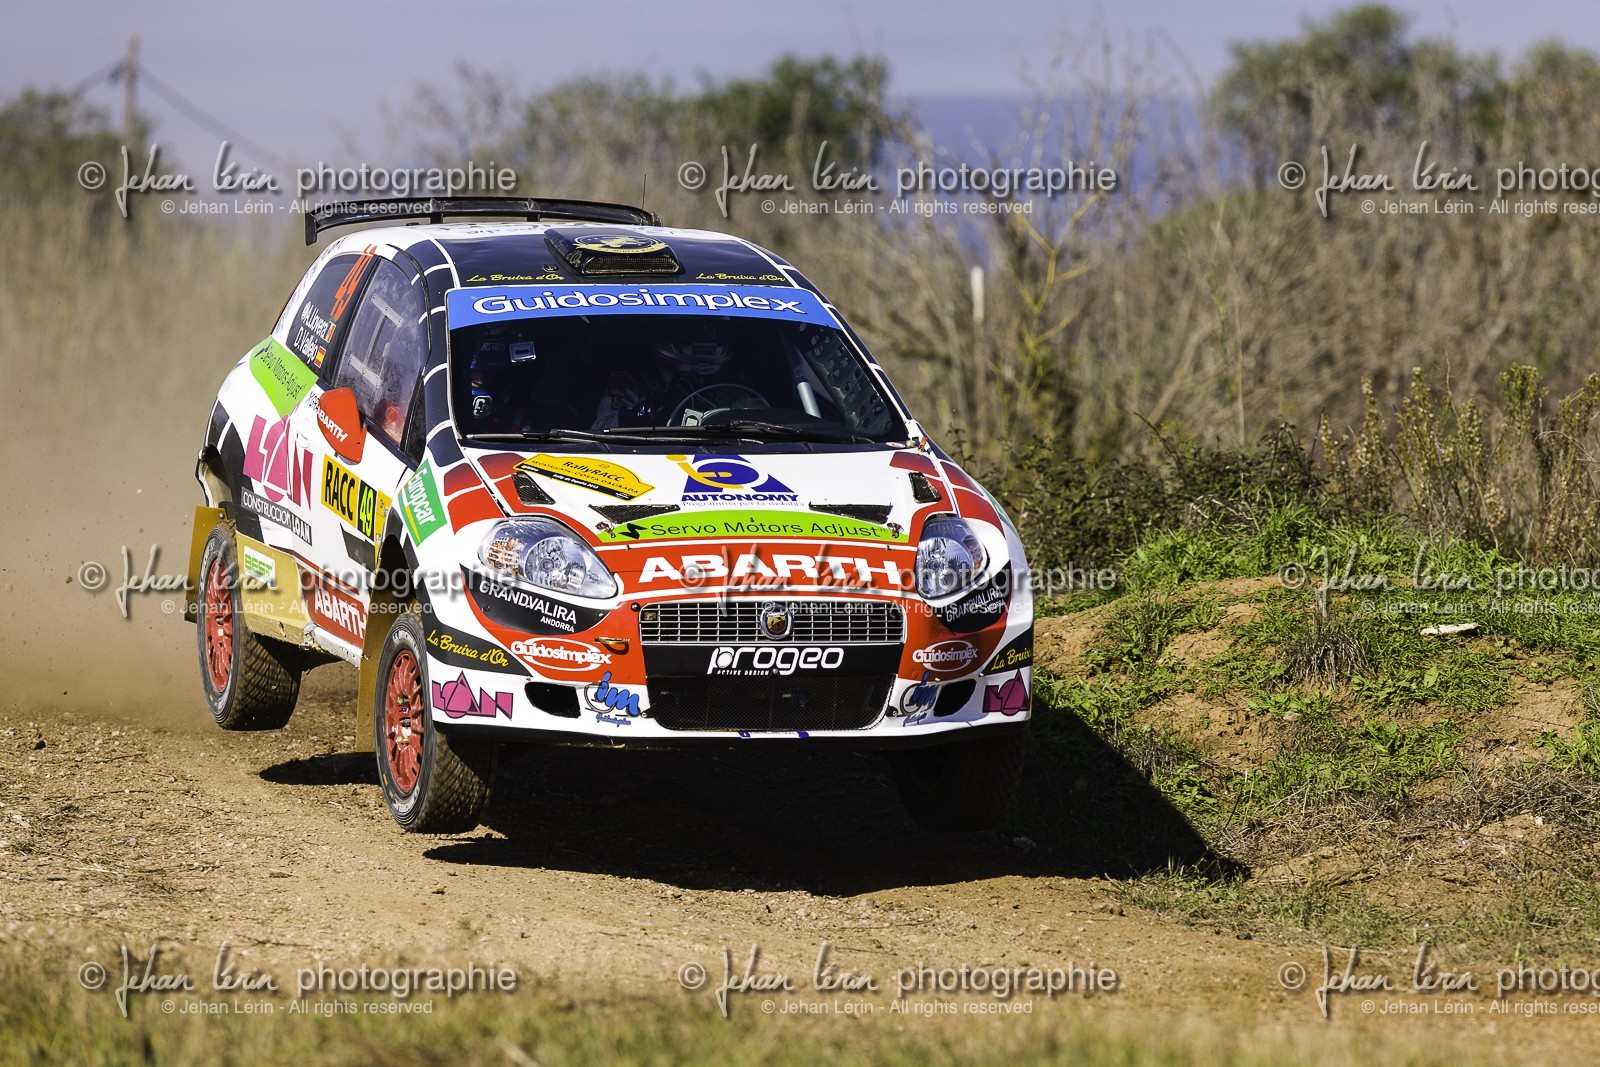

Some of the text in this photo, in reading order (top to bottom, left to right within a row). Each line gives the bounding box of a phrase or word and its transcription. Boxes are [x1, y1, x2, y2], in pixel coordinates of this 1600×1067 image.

[466, 274, 488, 282] La
[715, 272, 757, 280] Bruixa
[472, 288, 807, 314] Guidosimplex
[562, 461, 625, 483] RallyRACC
[325, 461, 374, 537] RACC 49
[407, 467, 437, 526] Europcar
[681, 494, 799, 502] AUTONOMY
[292, 513, 311, 544] LOAN
[651, 522, 716, 536] Servo
[724, 520, 804, 534] Motors
[638, 553, 902, 585] ABARTH
[315, 585, 367, 639] ABARTH
[480, 580, 577, 624] GRANDVALIRA
[540, 616, 575, 633] ANDORRA
[426, 629, 439, 646] La
[440, 634, 479, 659] Bruixa
[480, 648, 509, 667] d'Or
[510, 640, 612, 664] Guidosimplex
[912, 648, 978, 663] Guidosimplex
[706, 647, 844, 676] progeo
[991, 653, 1006, 671] La
